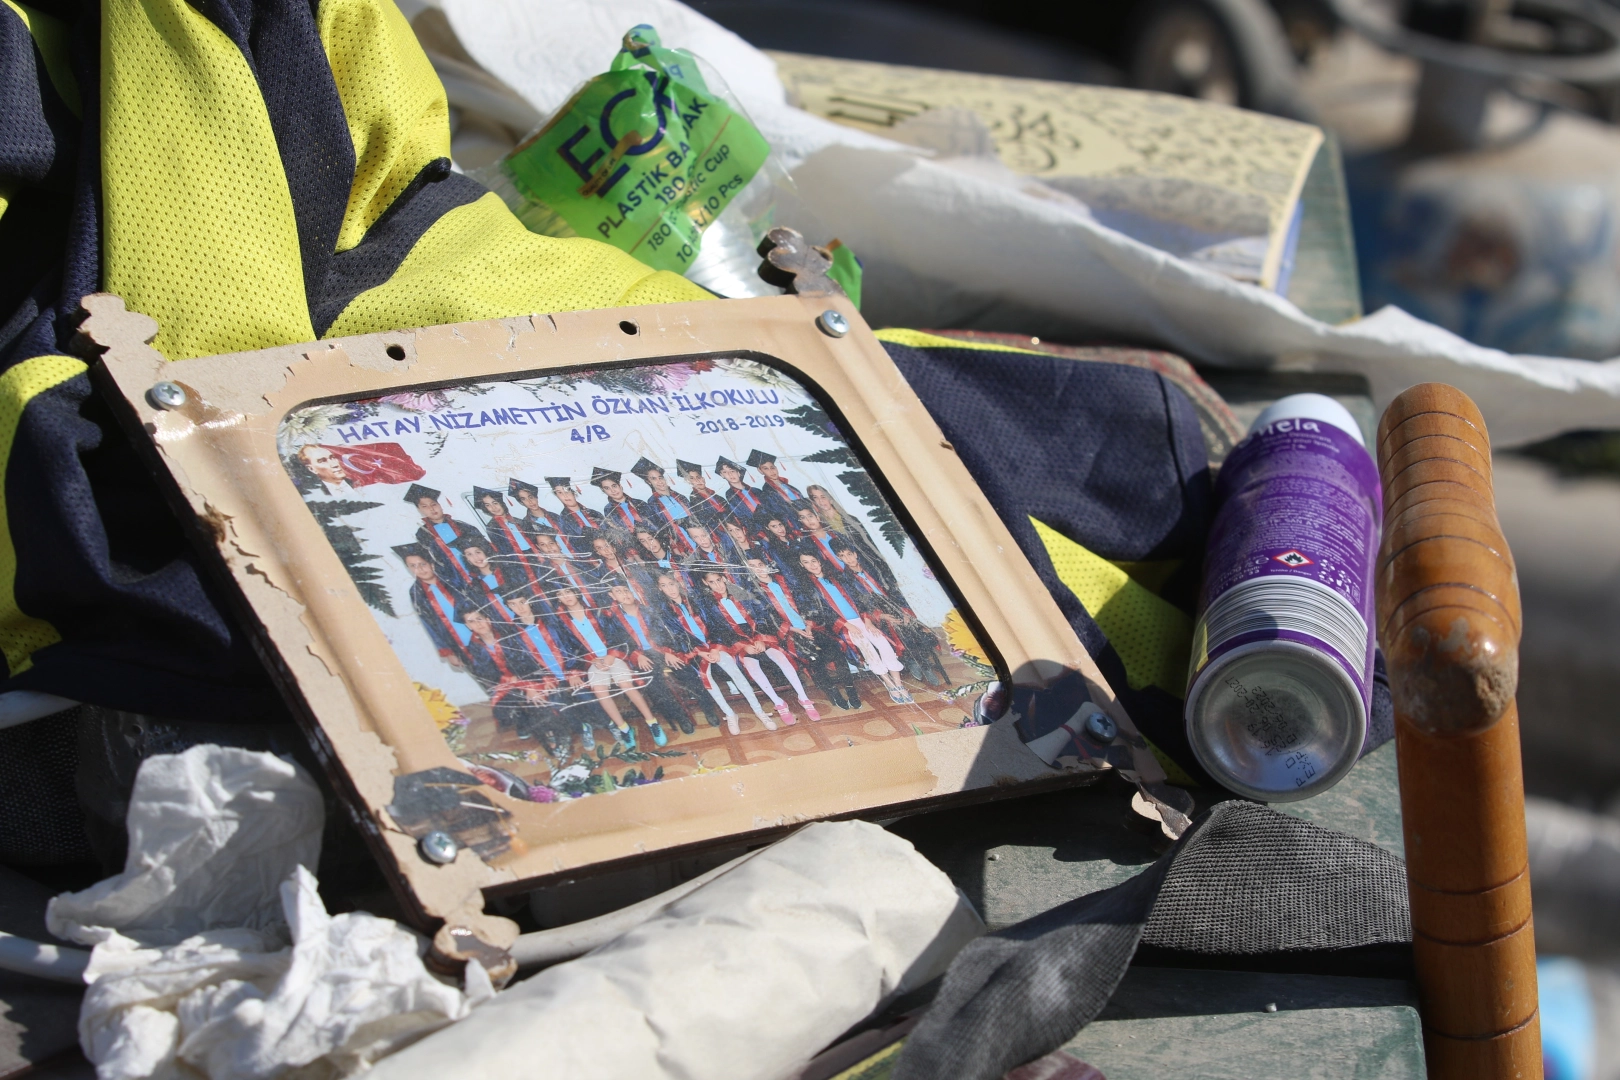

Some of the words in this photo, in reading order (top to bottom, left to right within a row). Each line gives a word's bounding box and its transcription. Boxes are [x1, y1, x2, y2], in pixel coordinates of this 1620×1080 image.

[597, 163, 669, 239] PLASTİK
[647, 222, 673, 252] 180
[704, 144, 731, 173] Cup
[654, 176, 686, 206] 180
[676, 242, 694, 264] 10
[718, 174, 744, 198] Pcs
[337, 416, 423, 444] HATAY
[432, 401, 587, 431] NİZAMETTİN
[591, 395, 670, 417] ÖZKAN
[673, 387, 780, 411] İLKOKULU
[570, 429, 611, 445] 4/B
[696, 414, 786, 435] 2018-2019
